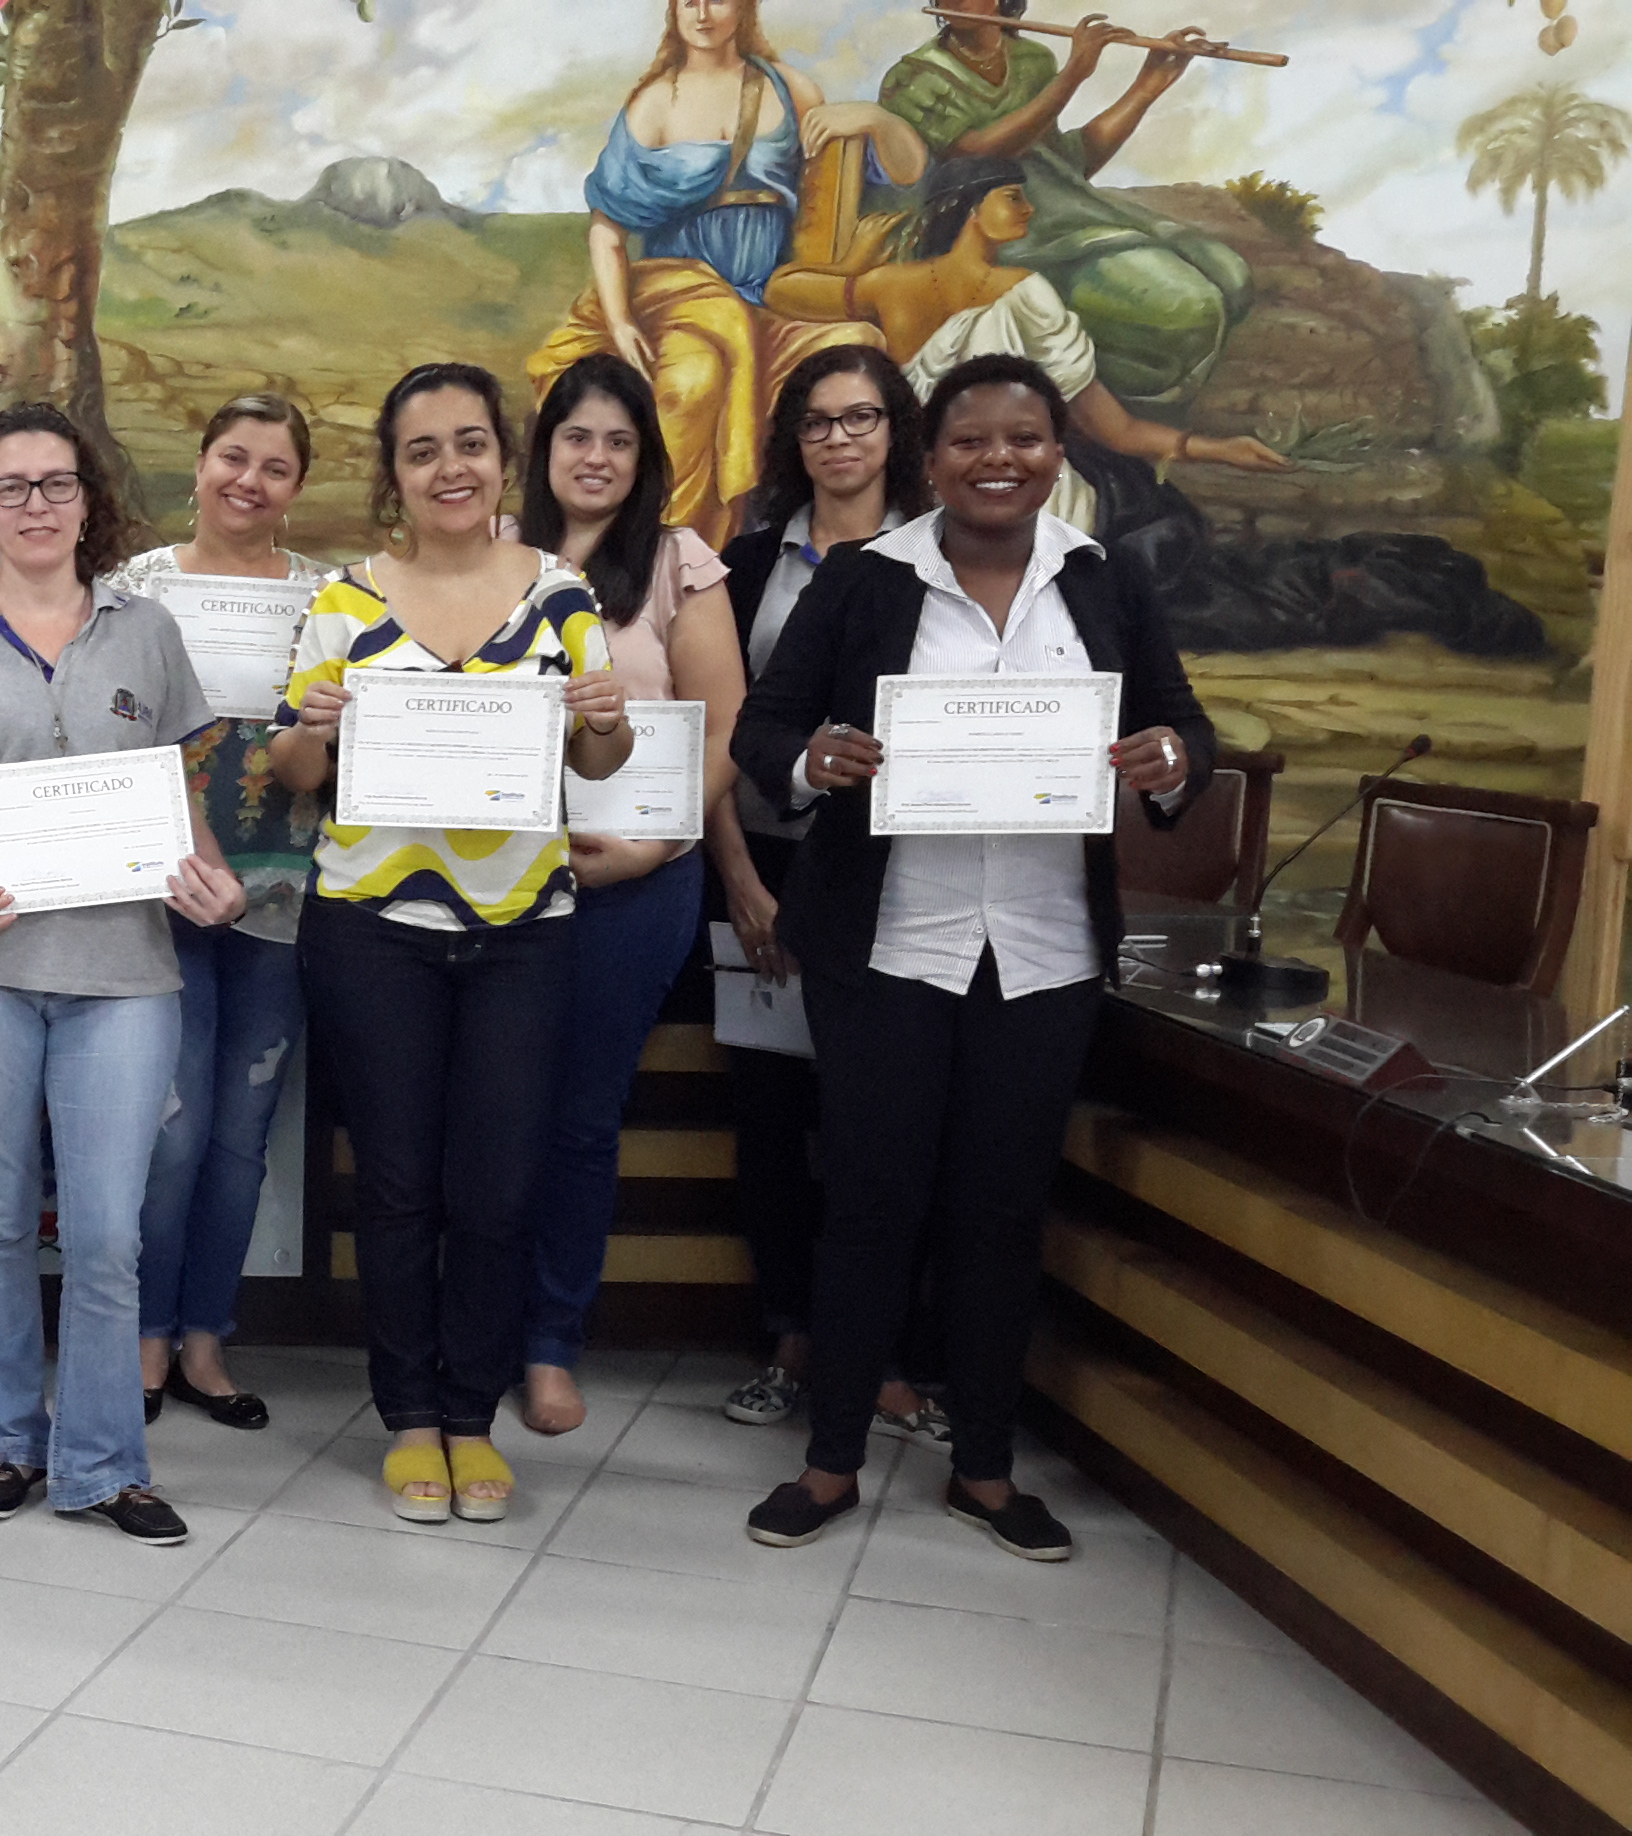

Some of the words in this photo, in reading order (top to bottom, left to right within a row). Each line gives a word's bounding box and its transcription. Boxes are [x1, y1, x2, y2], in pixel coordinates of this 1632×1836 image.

[201, 599, 295, 616] CERTIFICADO
[406, 698, 512, 714] CERTIFICADO
[944, 700, 1060, 715] CERTIFICADO
[33, 777, 133, 798] CERTIFICADO
